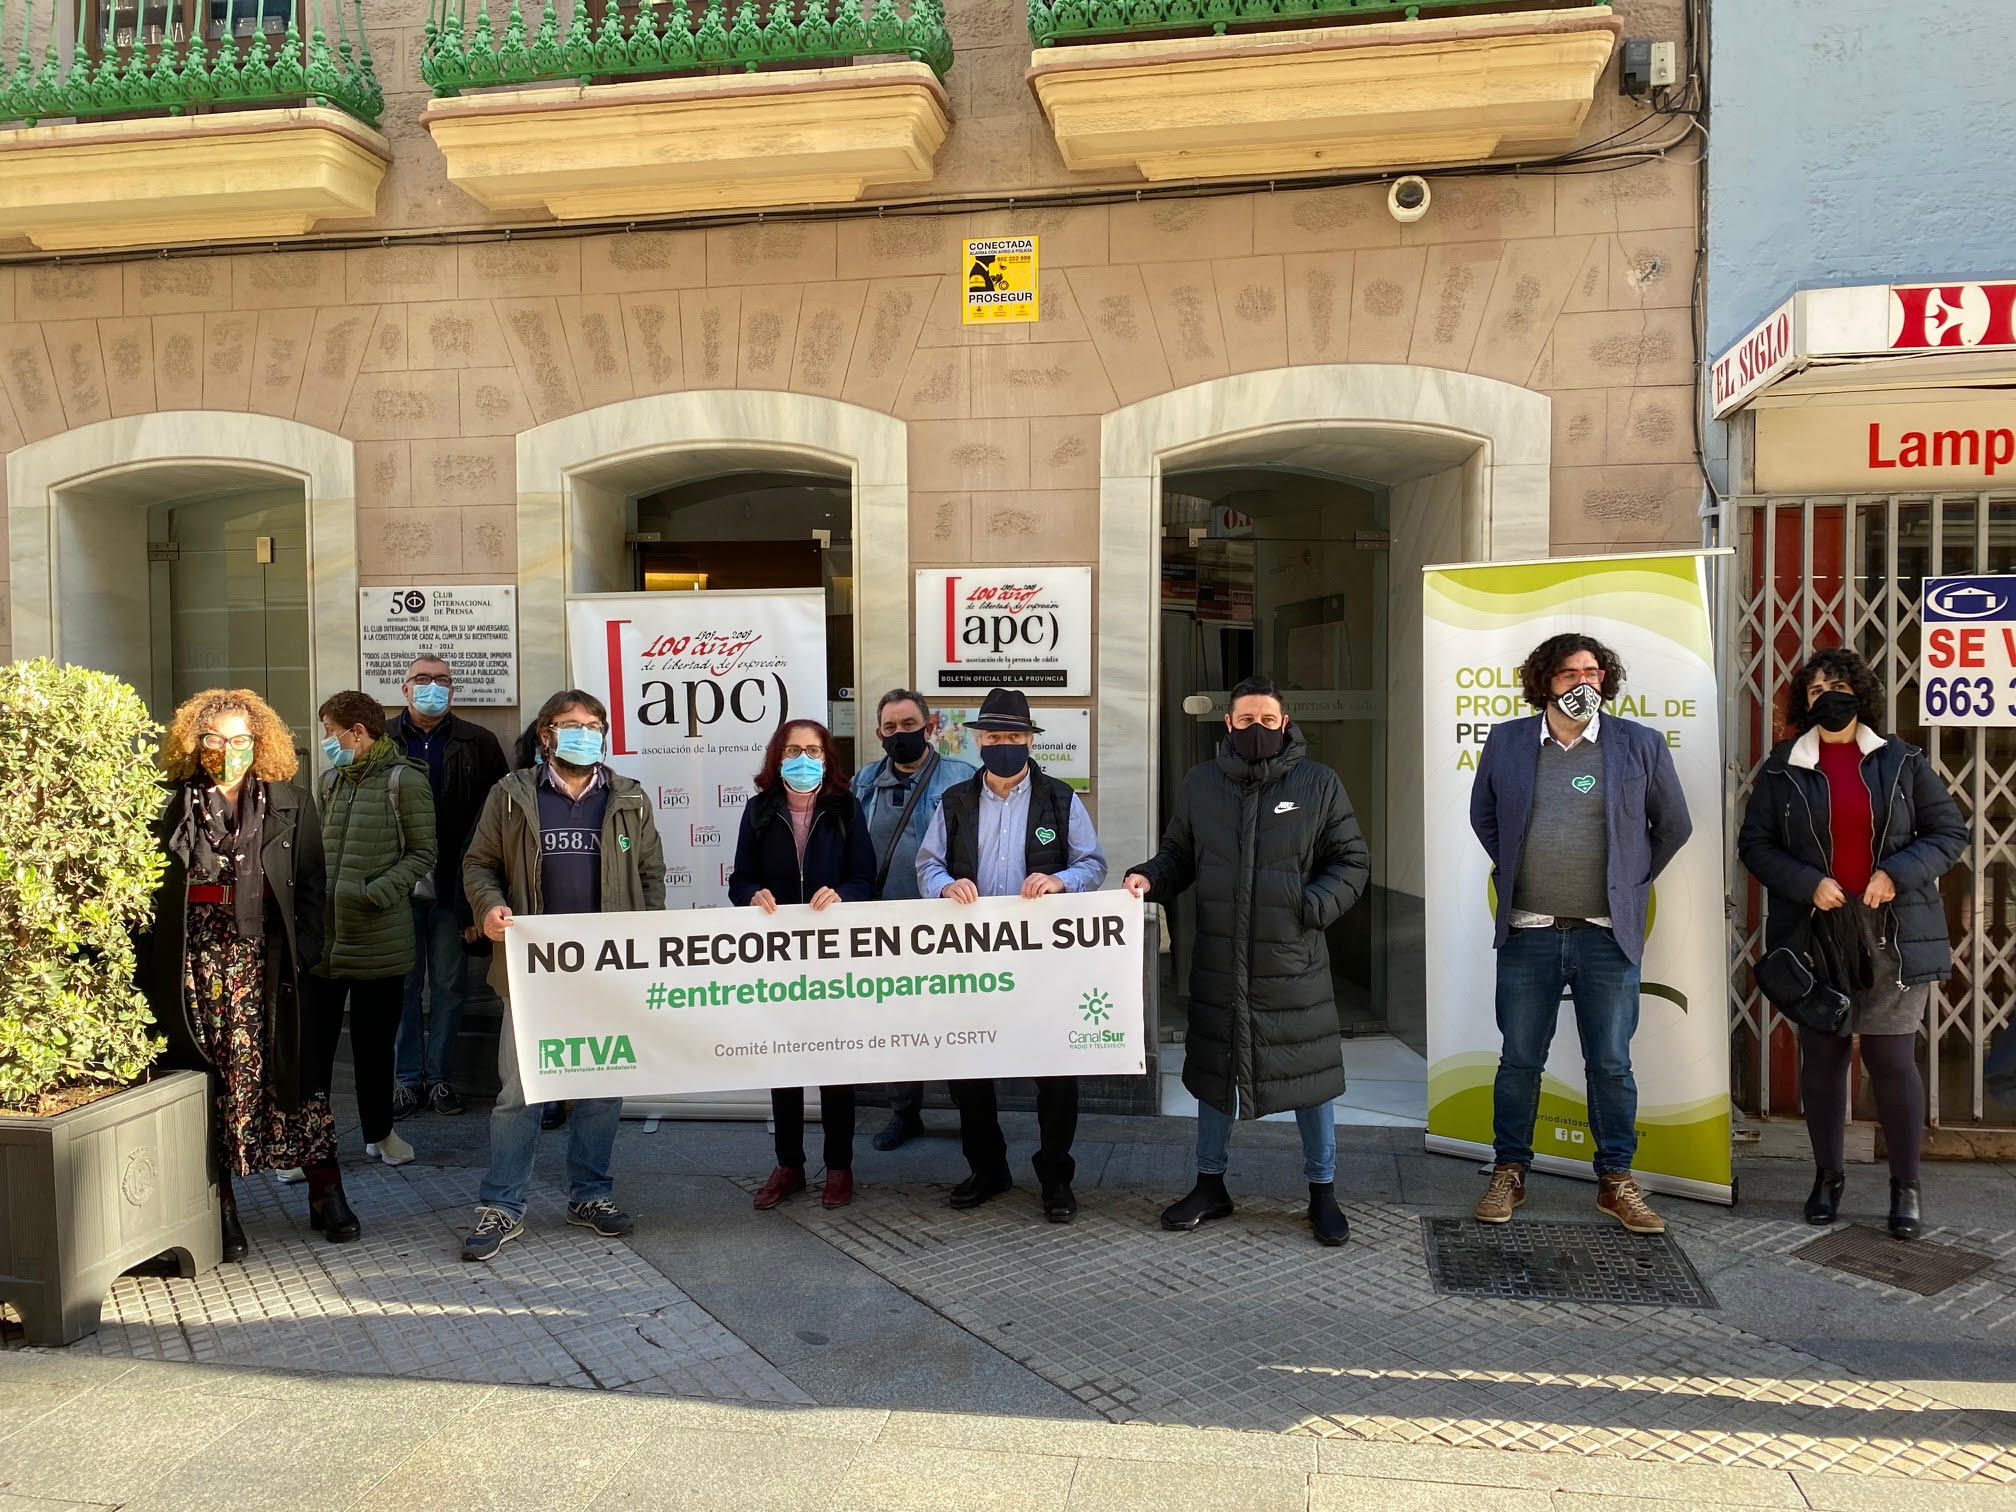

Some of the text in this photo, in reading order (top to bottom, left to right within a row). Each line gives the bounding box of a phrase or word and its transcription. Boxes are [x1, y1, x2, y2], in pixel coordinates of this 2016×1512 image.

[969, 240, 1032, 250] CONECTADA
[969, 292, 1032, 303] PROSEGUR
[1716, 313, 1789, 404] EL SIGLO
[1869, 422, 2016, 476] Lamp
[966, 586, 998, 601] 100
[979, 601, 1010, 609] libertad
[430, 624, 450, 632] PRENSA,
[375, 632, 410, 640] CONSTITUCIÓN
[419, 632, 434, 640] CÁDIZ
[641, 635, 691, 657] 100
[1928, 628, 1985, 668] SE
[390, 650, 416, 659] ESPAÑOLES
[1005, 655, 1011, 663] la
[1033, 655, 1040, 663] de
[1041, 655, 1059, 663] cádiz
[641, 655, 787, 672] de libertad de expresión
[365, 668, 387, 676] REVISIÓN
[941, 674, 971, 682] BOLETÍN
[1025, 674, 1064, 682] PROVINCIA
[485, 677, 495, 685] QUE
[1926, 677, 1995, 717] 663
[1665, 700, 1696, 717] DE
[642, 742, 762, 755] asociación de la prensa de
[1032, 742, 1077, 750] esional de
[1035, 753, 1072, 761] SOCIAL
[528, 915, 1126, 974] NO AL RECORTE EN CANAL SUR
[645, 971, 1016, 1010] #entretodasloparamos
[714, 1030, 997, 1057] Comité Intercentros de RTVA y CSRTV
[539, 1035, 637, 1069] RTVA
